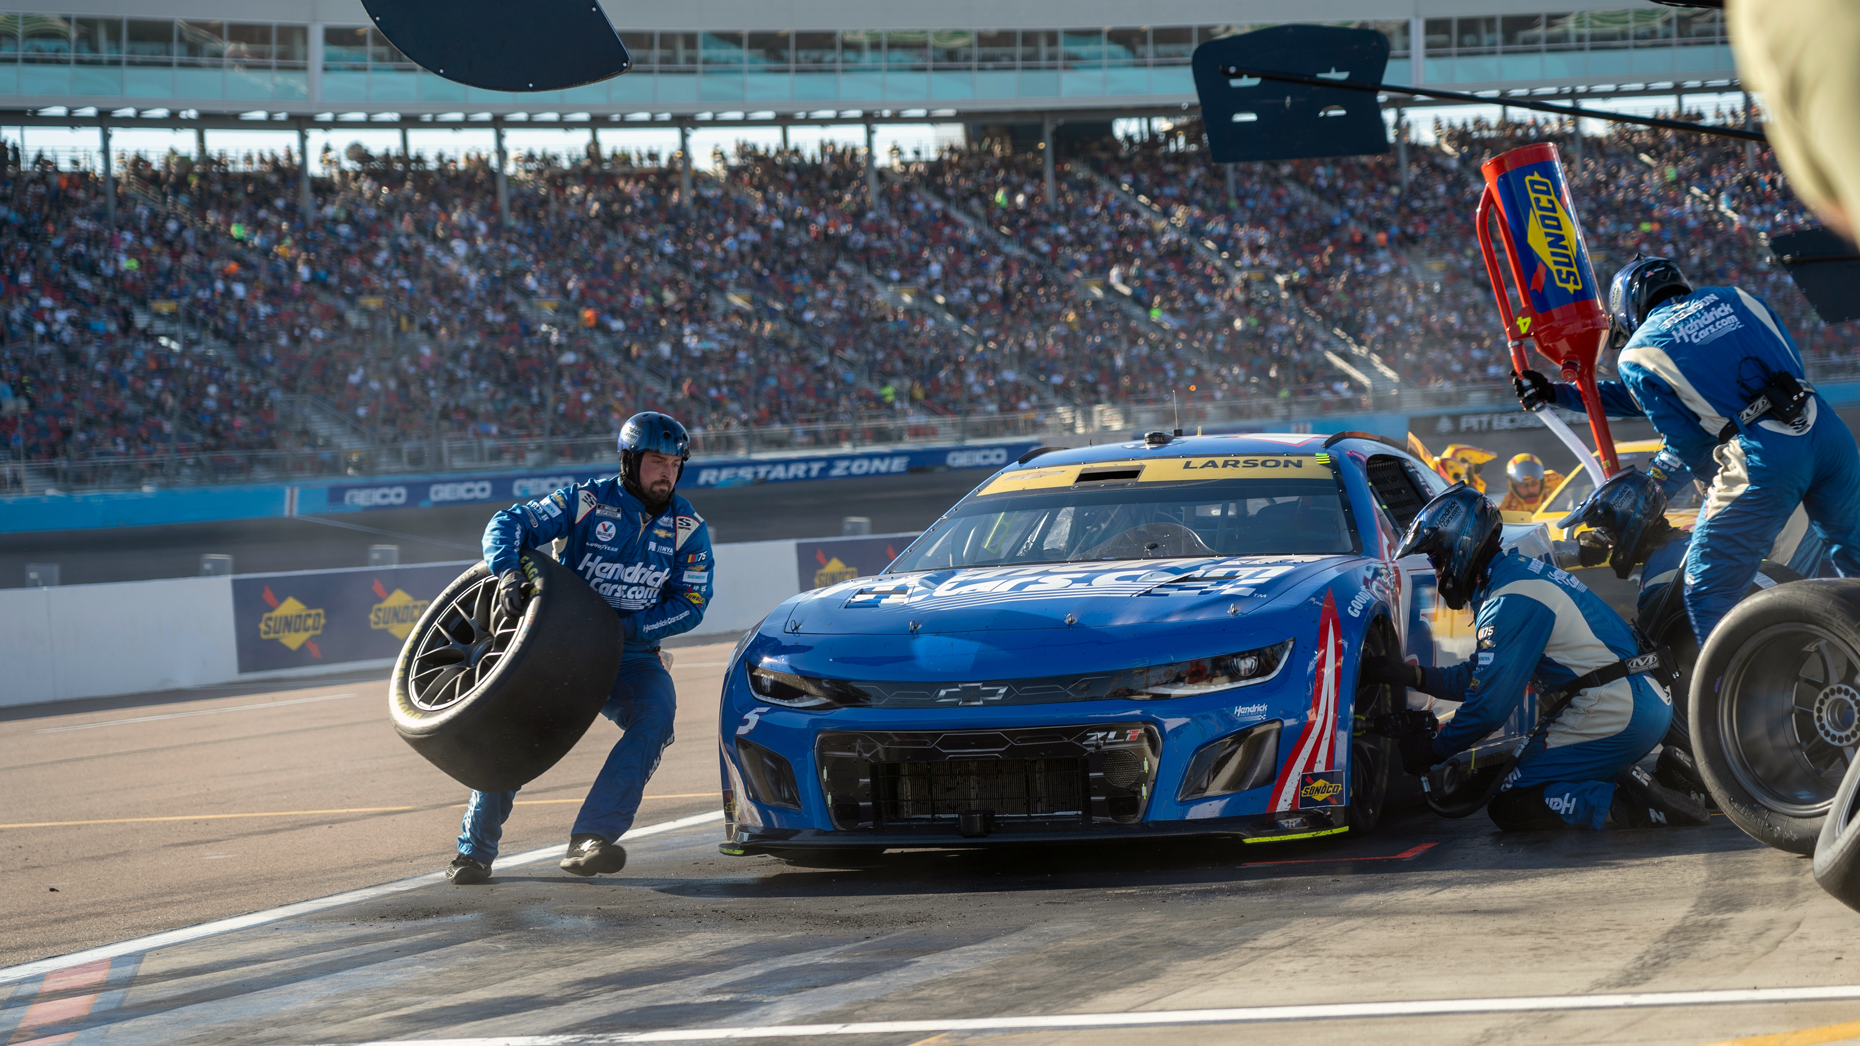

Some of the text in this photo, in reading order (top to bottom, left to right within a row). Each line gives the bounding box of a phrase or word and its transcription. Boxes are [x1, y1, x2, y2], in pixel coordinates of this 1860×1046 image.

[1530, 178, 1580, 286] SUNOCO
[1516, 316, 1532, 334] 4
[1672, 302, 1734, 344] Hendrick
[1690, 314, 1739, 344] Cars.com
[946, 449, 1007, 468] GEICO
[1182, 459, 1303, 470] LARSON
[697, 456, 910, 486] RESTART ZONE
[345, 486, 407, 505] GEICO
[430, 481, 492, 501] GEICO
[512, 477, 575, 497] GEICO
[1436, 500, 1457, 528] Hendrick
[586, 542, 619, 552] GOODYEAR
[698, 551, 707, 561] 75
[577, 553, 672, 588] Hendrick
[589, 578, 661, 600] Cars.com
[262, 612, 322, 636] SUNOCO
[643, 610, 691, 633] HendrickCars.com
[1484, 625, 1495, 640] 75
[1234, 703, 1268, 717] Hendrick
[735, 706, 772, 736] 5
[1082, 729, 1141, 746] ZL1
[1302, 783, 1341, 797] SUNOCO
